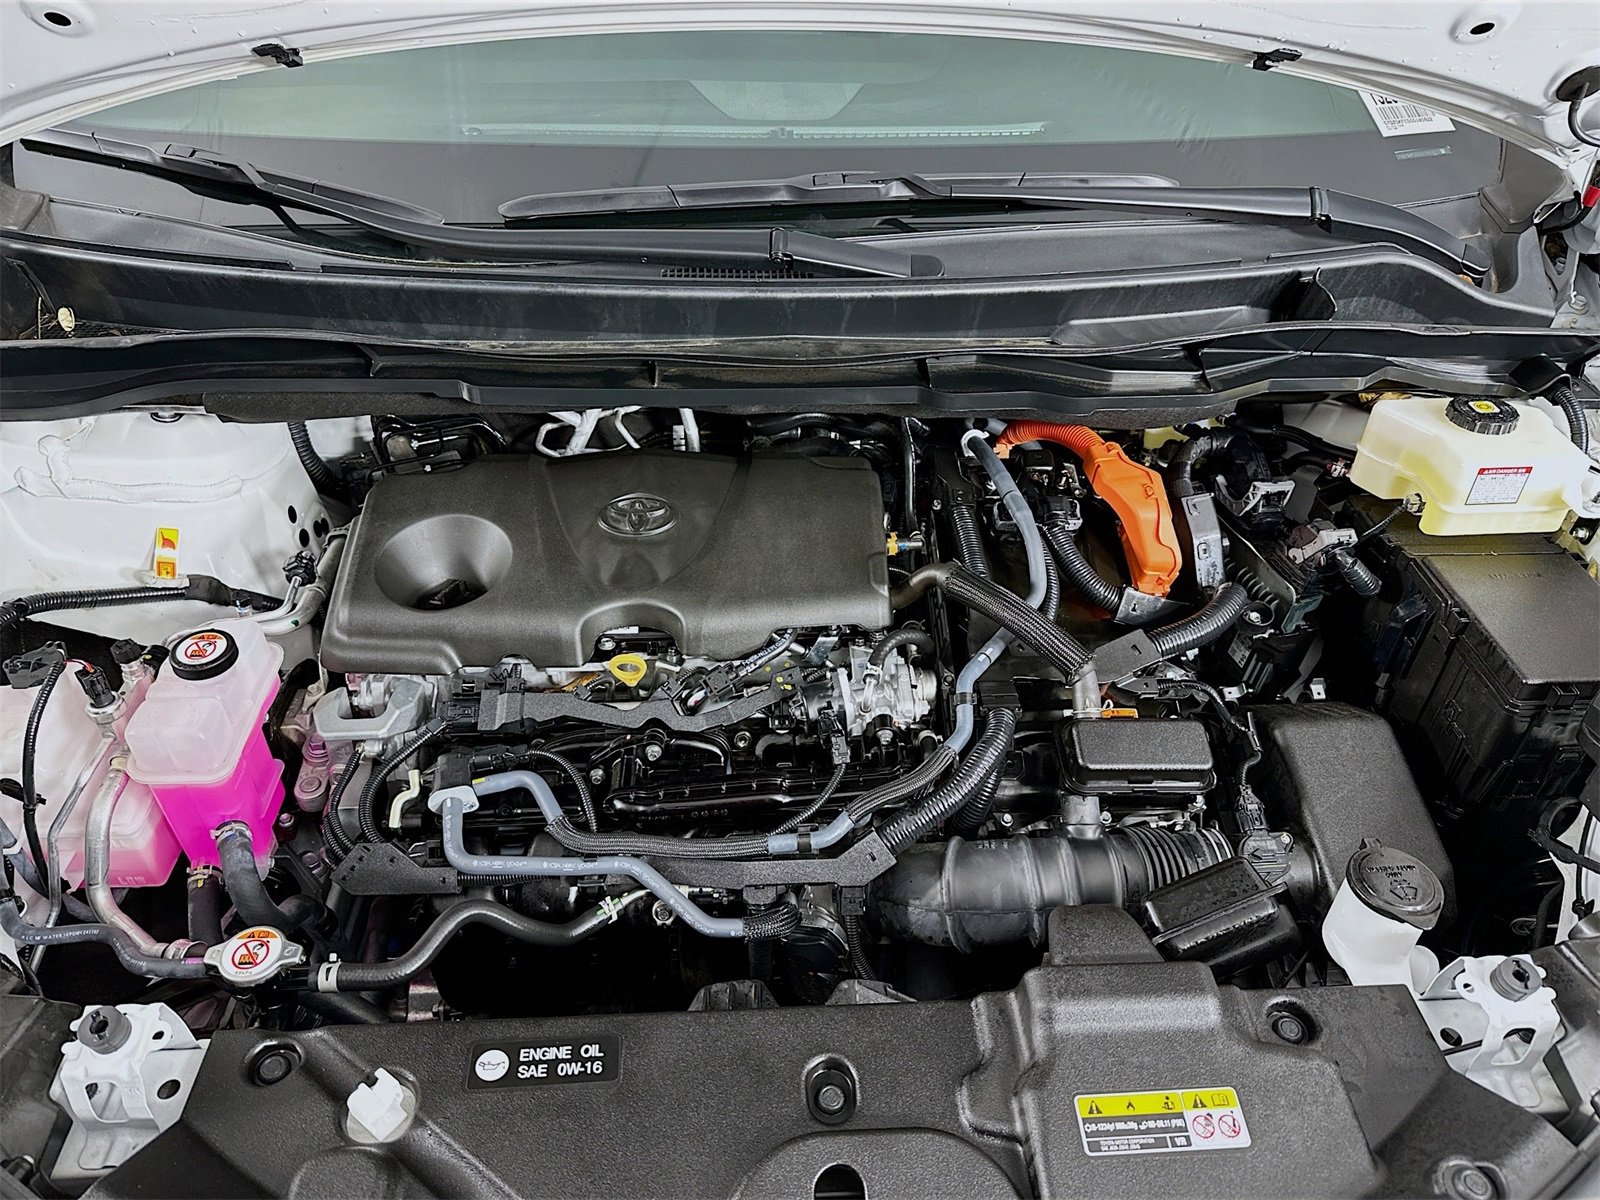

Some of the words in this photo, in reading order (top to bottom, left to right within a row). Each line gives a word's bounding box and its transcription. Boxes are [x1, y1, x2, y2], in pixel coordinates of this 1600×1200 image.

[520, 1046, 572, 1061] ENGINE
[580, 1044, 605, 1058] OIL
[517, 1064, 549, 1079] SAE
[557, 1061, 603, 1077] 0W-16
